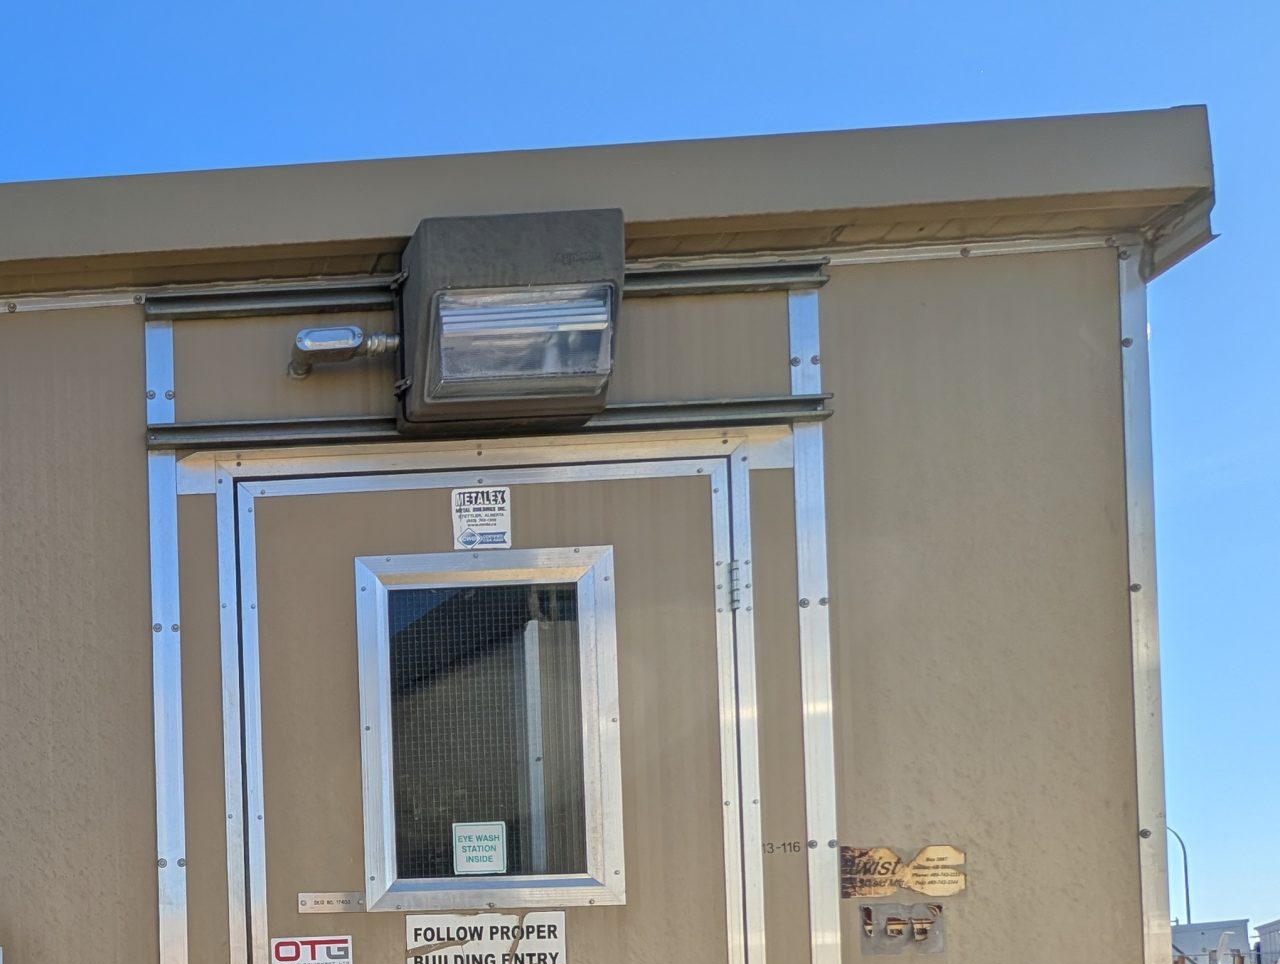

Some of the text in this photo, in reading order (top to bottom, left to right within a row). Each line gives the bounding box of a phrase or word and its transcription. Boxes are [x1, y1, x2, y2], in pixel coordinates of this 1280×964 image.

[455, 490, 506, 506] METALEX
[475, 834, 500, 842] WASH
[462, 845, 496, 853] STATION
[761, 841, 801, 854] 13-116
[466, 855, 494, 863] INSIDE
[414, 924, 558, 942] FOLLOW PROPER
[275, 939, 349, 962] OTG
